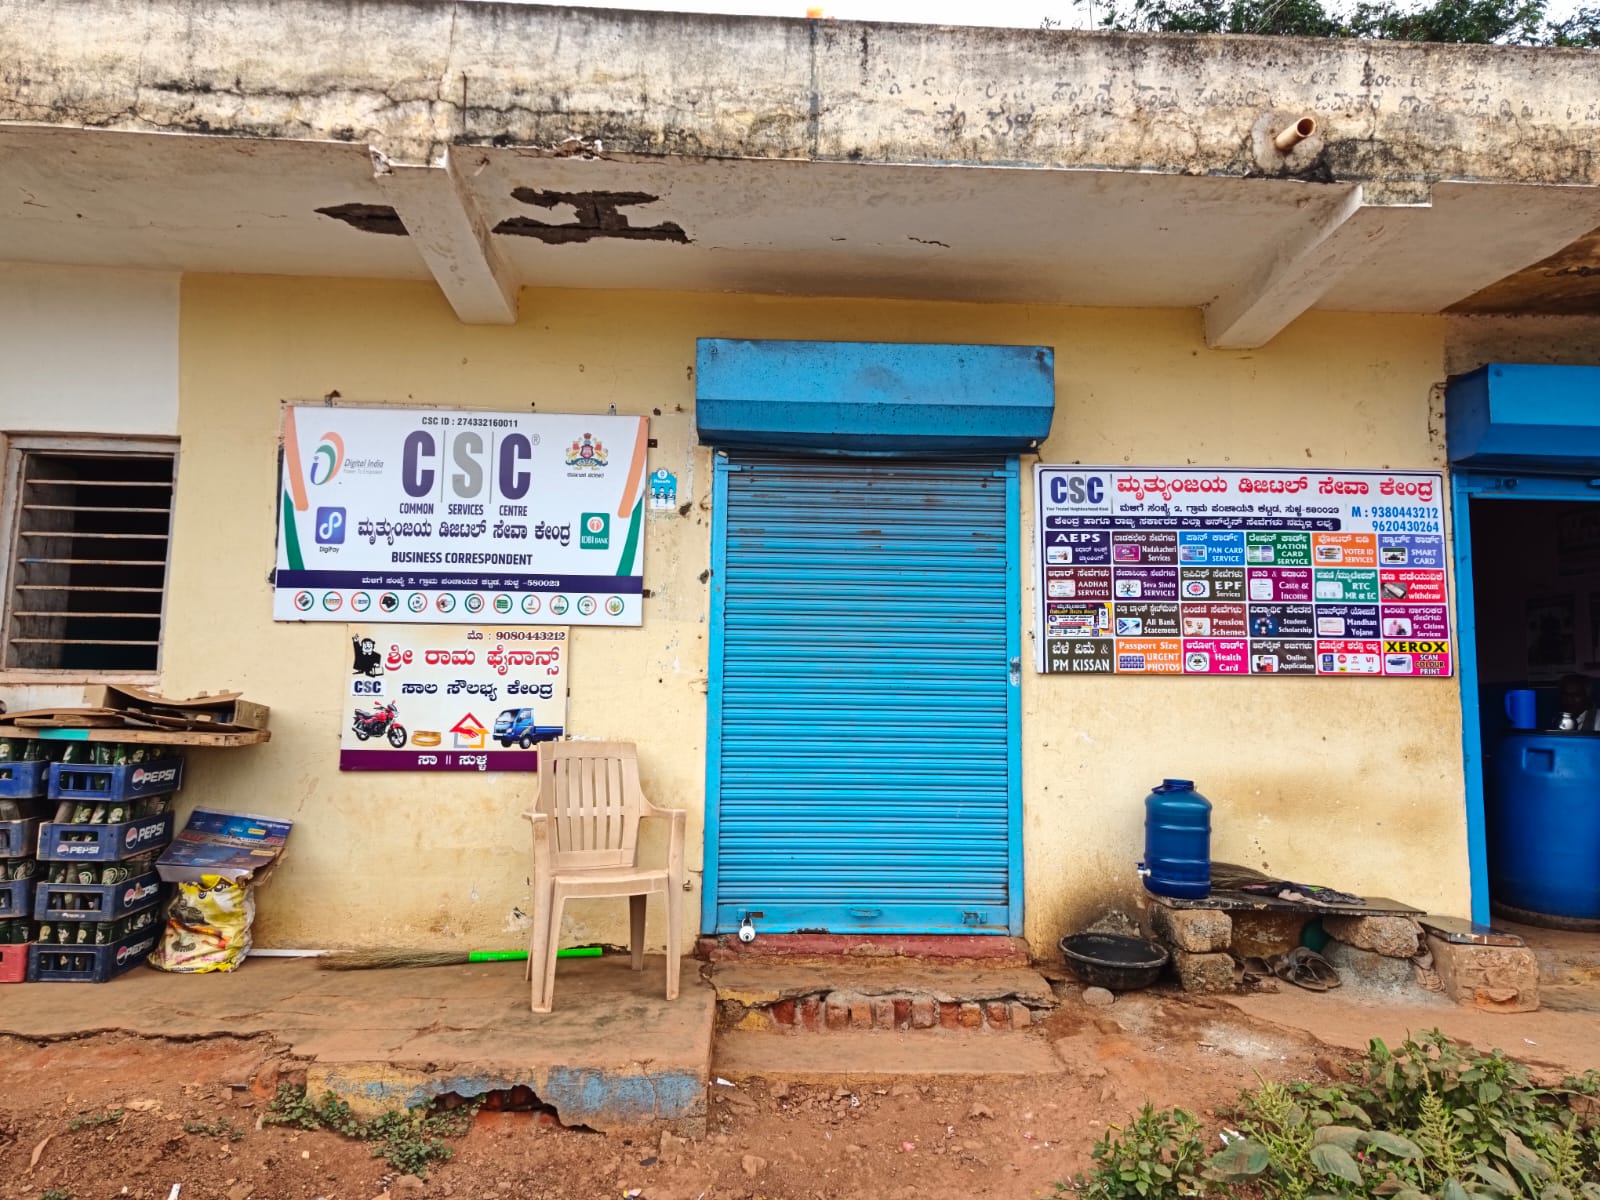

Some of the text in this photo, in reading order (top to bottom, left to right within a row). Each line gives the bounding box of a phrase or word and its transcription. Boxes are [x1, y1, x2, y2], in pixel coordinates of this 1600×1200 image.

[422, 417, 438, 425] CSC
[457, 418, 518, 428] 274332160011
[344, 458, 384, 468] Digital India
[1050, 476, 1104, 504] CSC
[1117, 474, 1228, 501] ಮೃತ್ಯುಂಜಯ
[1318, 476, 1369, 496] ಸೇವಾ
[1380, 478, 1432, 502] ಕೇಂದ್ರ
[400, 502, 528, 516] COMMON SERVICES CENTRE
[1352, 506, 1362, 517] M
[1371, 506, 1438, 519] 9380443212
[1054, 517, 1079, 527] ಕೇಂದ್ರ
[1372, 521, 1439, 532] 9620430264
[358, 517, 432, 545] ಮೃತ್ಯುಂಜಯ
[493, 520, 527, 539] ಸೇವಾ
[535, 521, 570, 546] ಕೇಂದ್ರ
[582, 536, 608, 544] IDBI BANK
[1055, 534, 1100, 542] AEPS
[320, 546, 340, 554] DigiPay
[392, 552, 533, 565] BUSINESS CORRESPONDENT
[1215, 581, 1242, 590] EPF
[496, 632, 566, 641] 9080443212
[1100, 644, 1109, 654] &
[1119, 642, 1156, 650] Passport
[1387, 642, 1445, 652] XEROX
[385, 644, 560, 676] ಶ್ರೀ ರಾಮ ಫೈನಾನ್ಸ್
[1053, 659, 1109, 671] PM KISSAN
[354, 681, 382, 693] CSC
[402, 680, 553, 701] ಸಾಲ ಸೌಲಭ್ಯ ಕೇಂದ್ರ
[143, 768, 176, 784] PEPSI
[138, 821, 165, 842] PEPSI
